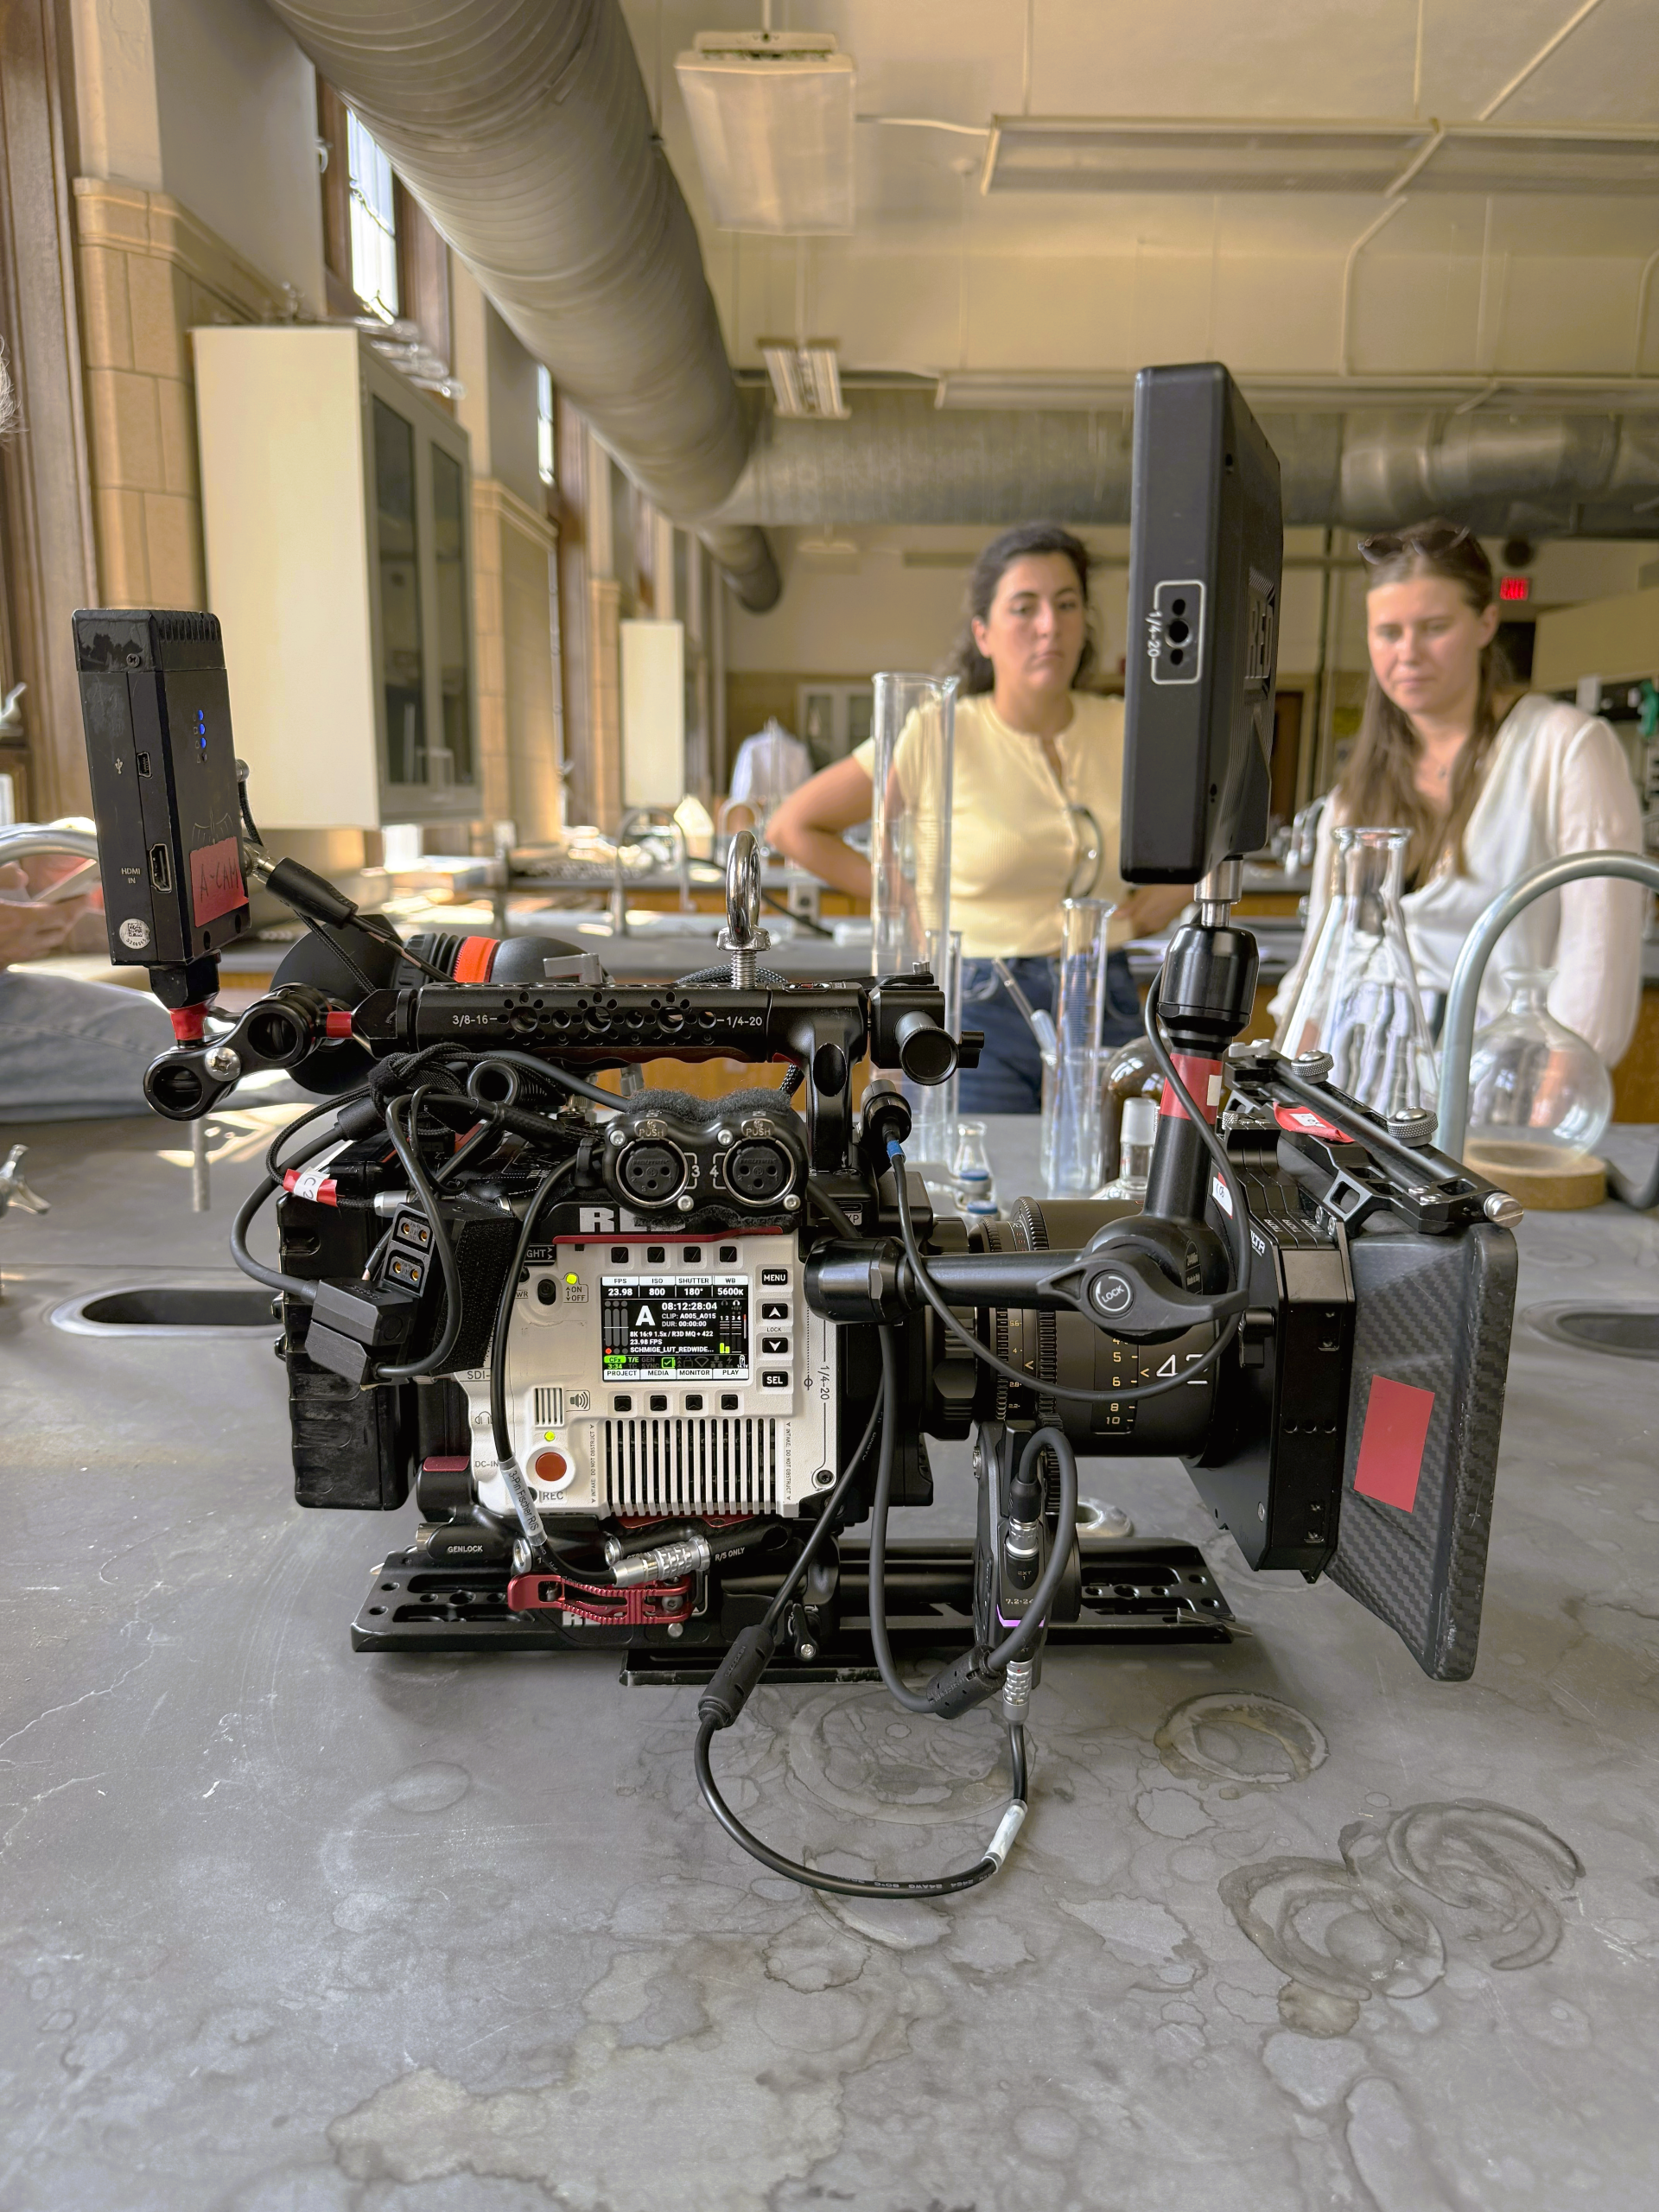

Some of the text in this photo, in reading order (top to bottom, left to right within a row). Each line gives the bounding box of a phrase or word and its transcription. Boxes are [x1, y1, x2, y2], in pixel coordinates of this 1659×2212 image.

[1145, 610, 1163, 658] 1/4-20
[452, 1014, 489, 1027] 3/8-16
[726, 1016, 763, 1028] 1/4-20
[639, 1128, 664, 1137] PUSH
[746, 1128, 772, 1136] PUSH
[691, 1165, 701, 1177] 3
[709, 1165, 720, 1177] 4
[526, 1249, 546, 1258] GHT
[683, 1287, 703, 1296] 180°
[1102, 1285, 1125, 1303] LOCK
[661, 1302, 717, 1311] 08:12:28:04
[635, 1305, 656, 1326] A
[1113, 1351, 1122, 1363] 5
[817, 1365, 830, 1401] 1/4-20
[1112, 1376, 1121, 1387] 6
[1110, 1403, 1119, 1412] 8
[1106, 1416, 1121, 1425] 10
[508, 1470, 539, 1531] 3-Pin Fischer R/S
[543, 1491, 563, 1500] REC
[715, 1548, 746, 1561] R/S ONLY
